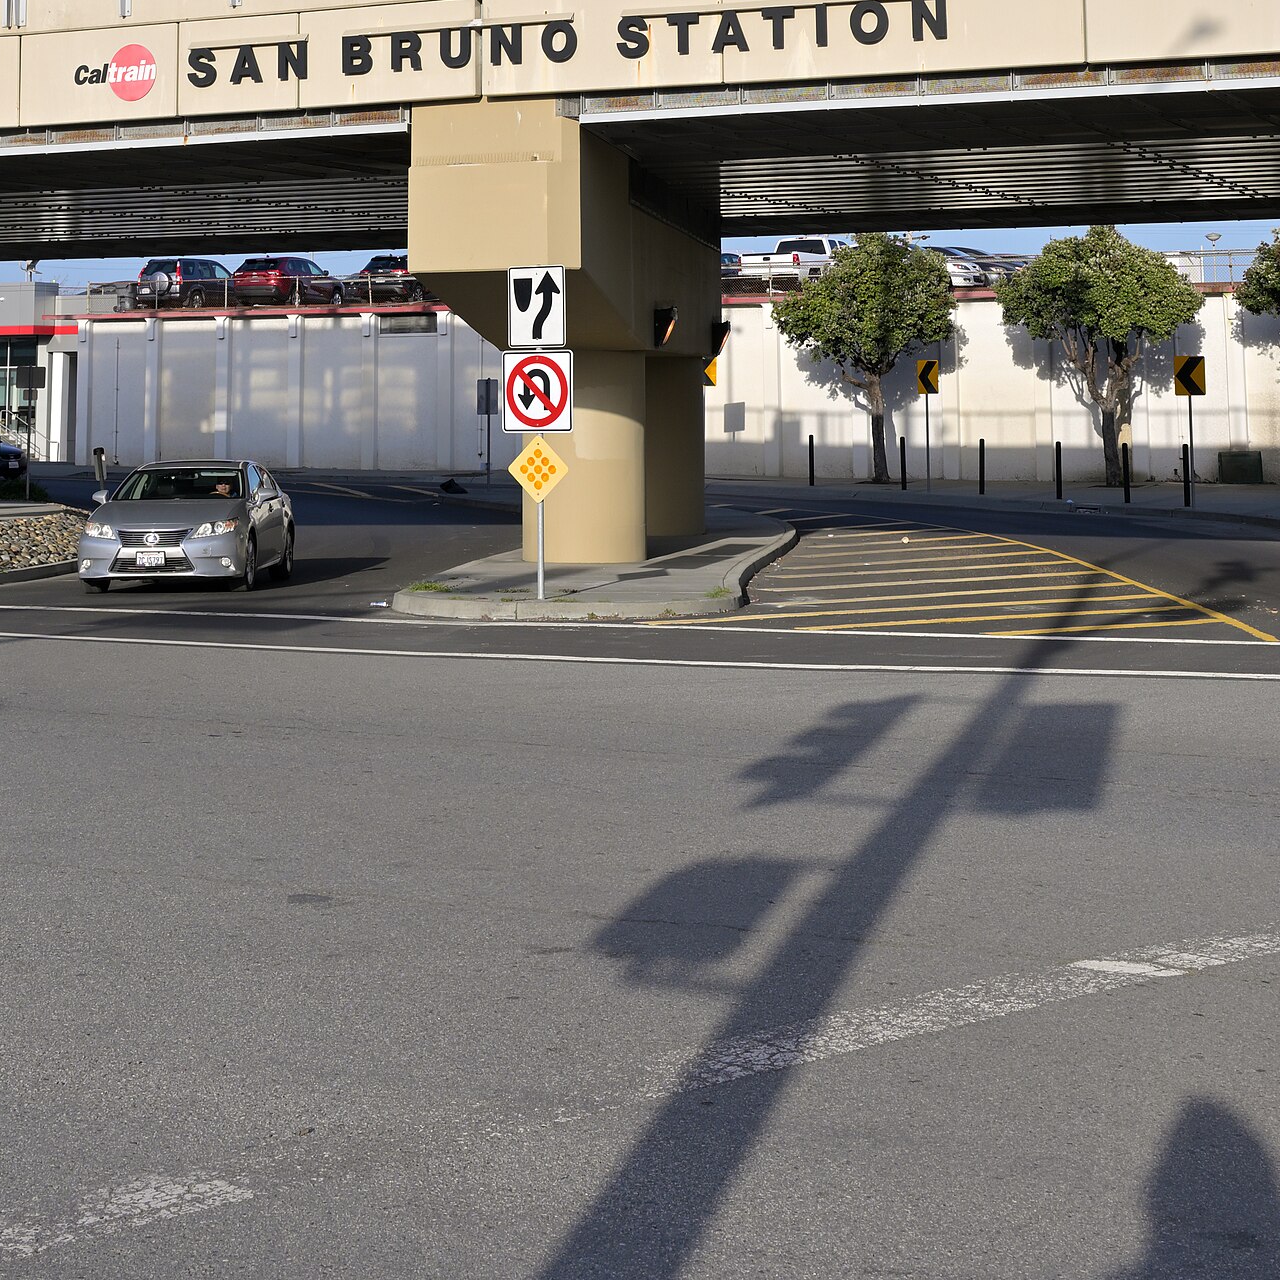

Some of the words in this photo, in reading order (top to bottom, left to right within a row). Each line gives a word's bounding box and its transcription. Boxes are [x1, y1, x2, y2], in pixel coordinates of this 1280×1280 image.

[73, 59, 157, 86] Caltrain
[187, 40, 309, 89] SAN
[341, 19, 579, 77] BRUNO
